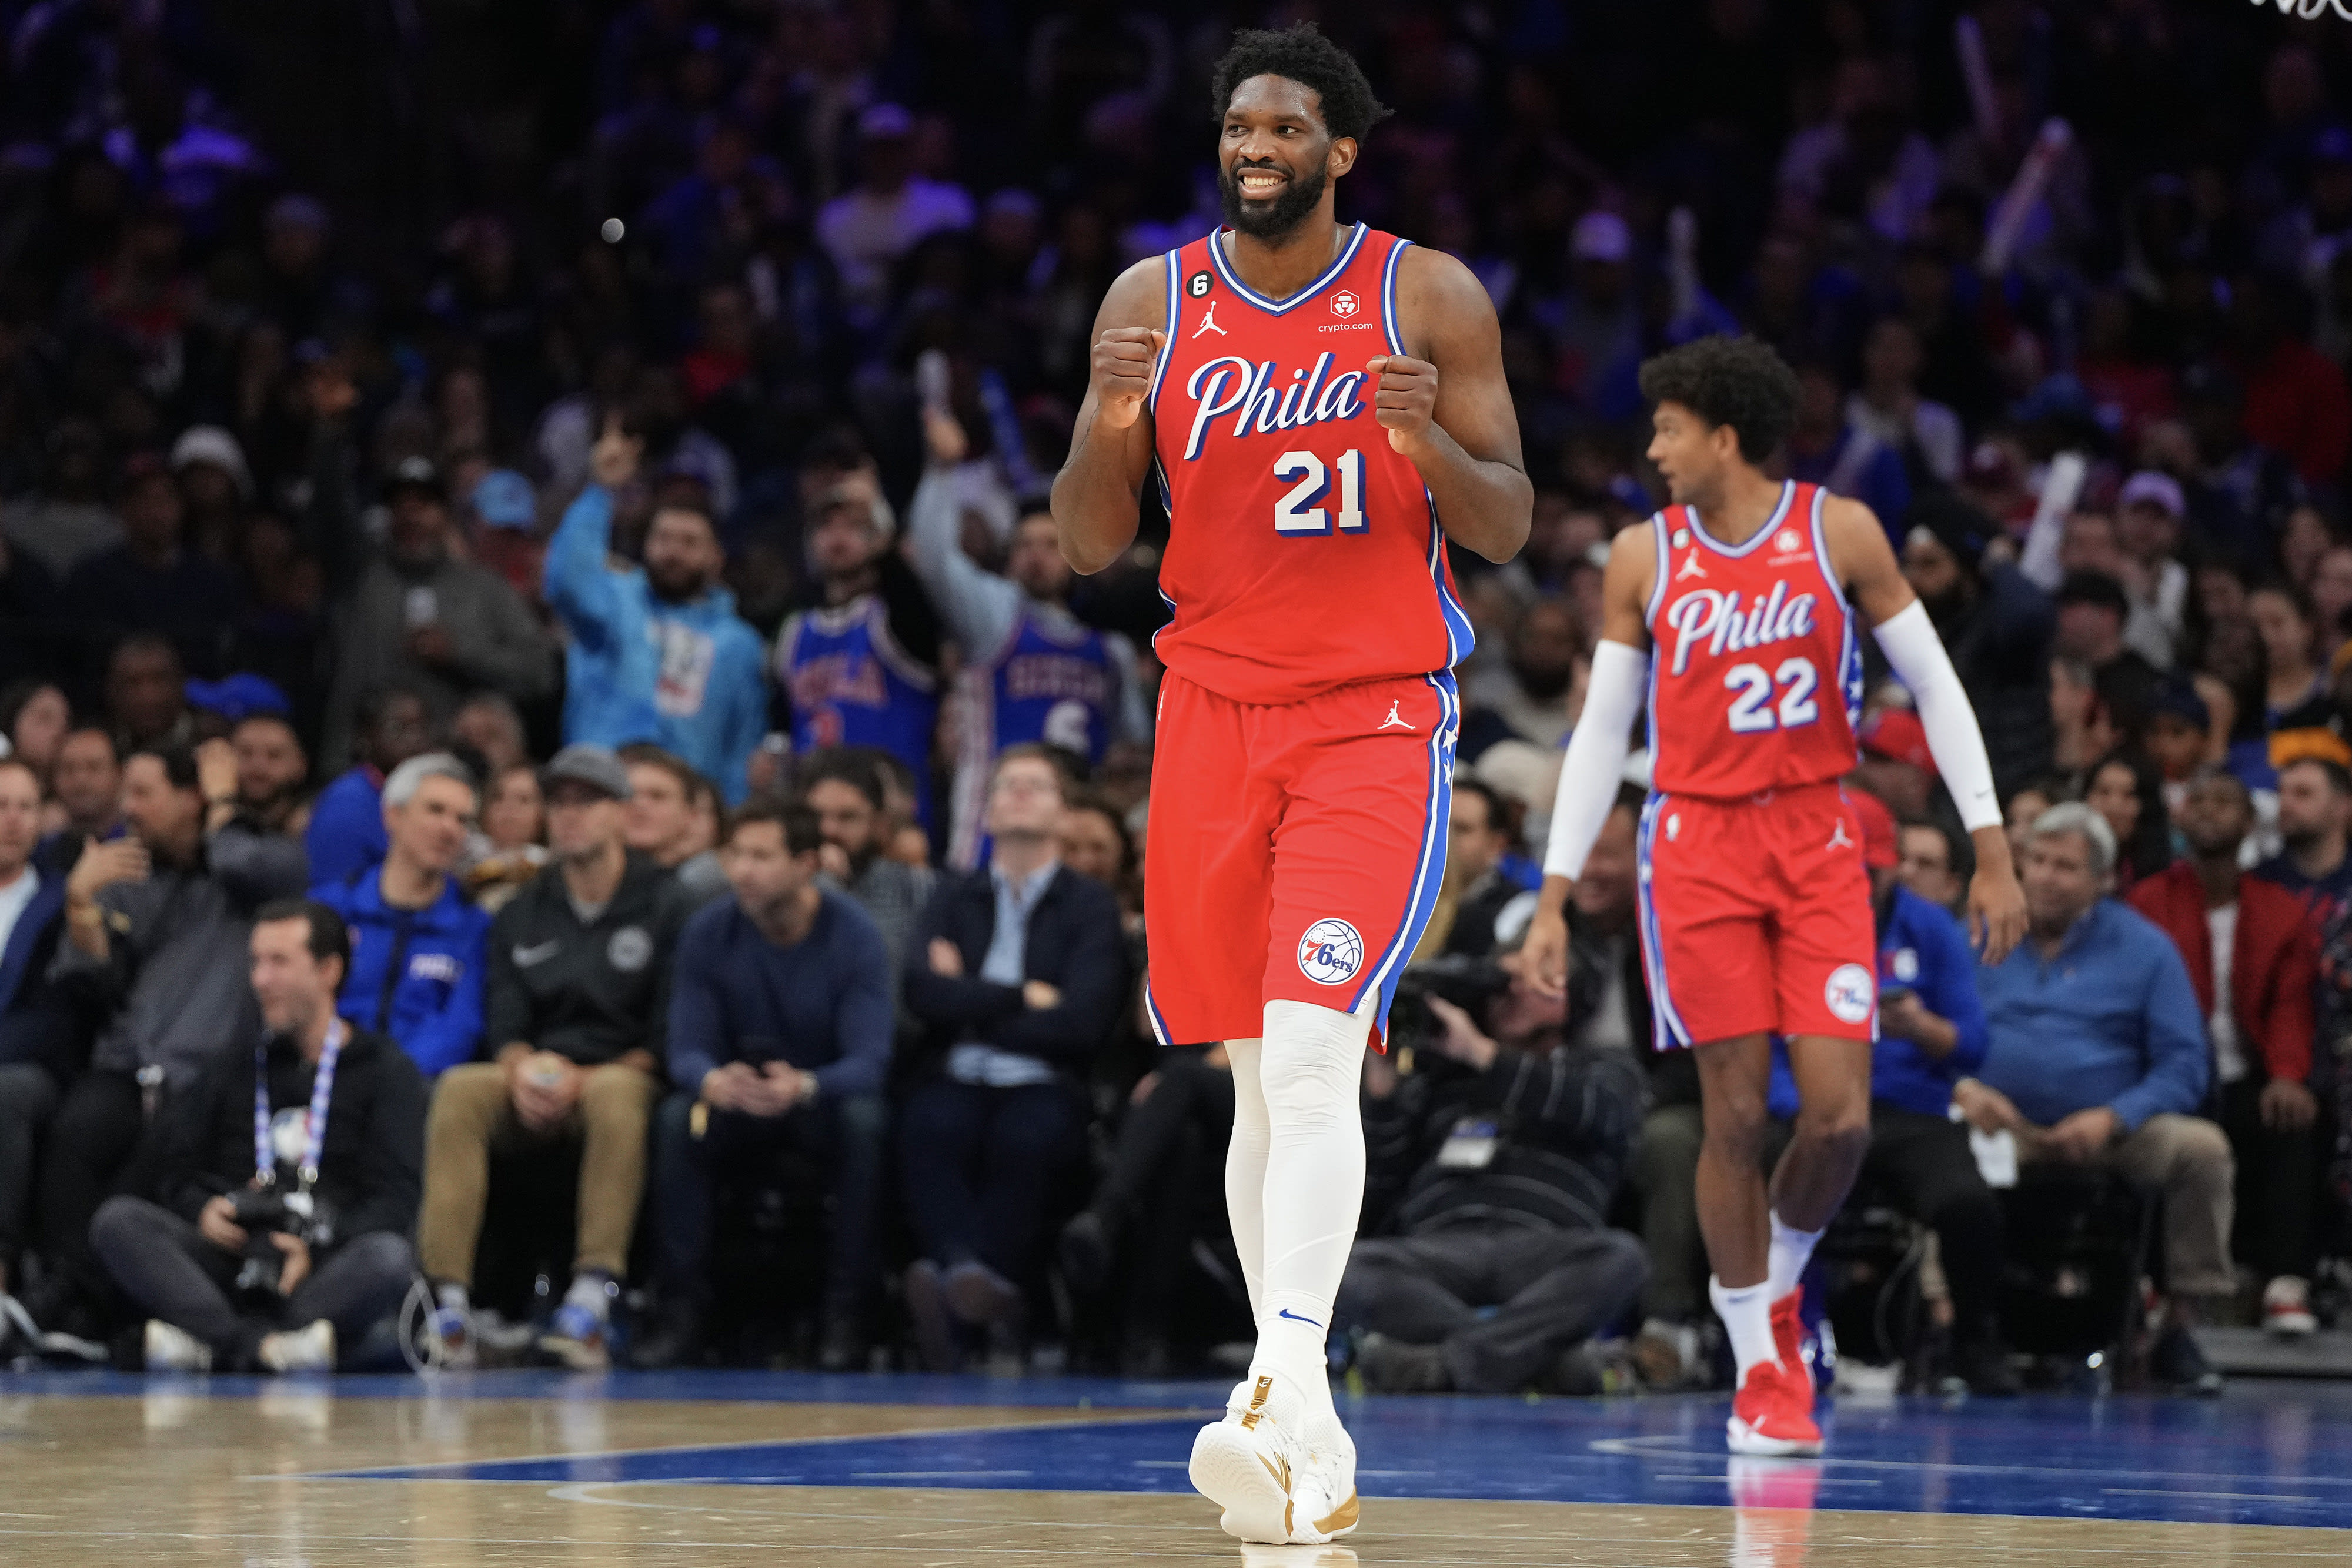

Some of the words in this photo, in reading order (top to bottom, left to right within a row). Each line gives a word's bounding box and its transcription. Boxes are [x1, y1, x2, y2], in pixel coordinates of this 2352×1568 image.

[1192, 275, 1208, 296] 6
[1318, 323, 1374, 333] crypto.com
[1183, 352, 1369, 462] Phila
[1274, 449, 1369, 537] 21
[1667, 579, 1818, 677] Phila
[1724, 657, 1819, 733] 22
[1303, 939, 1354, 972] 76ers
